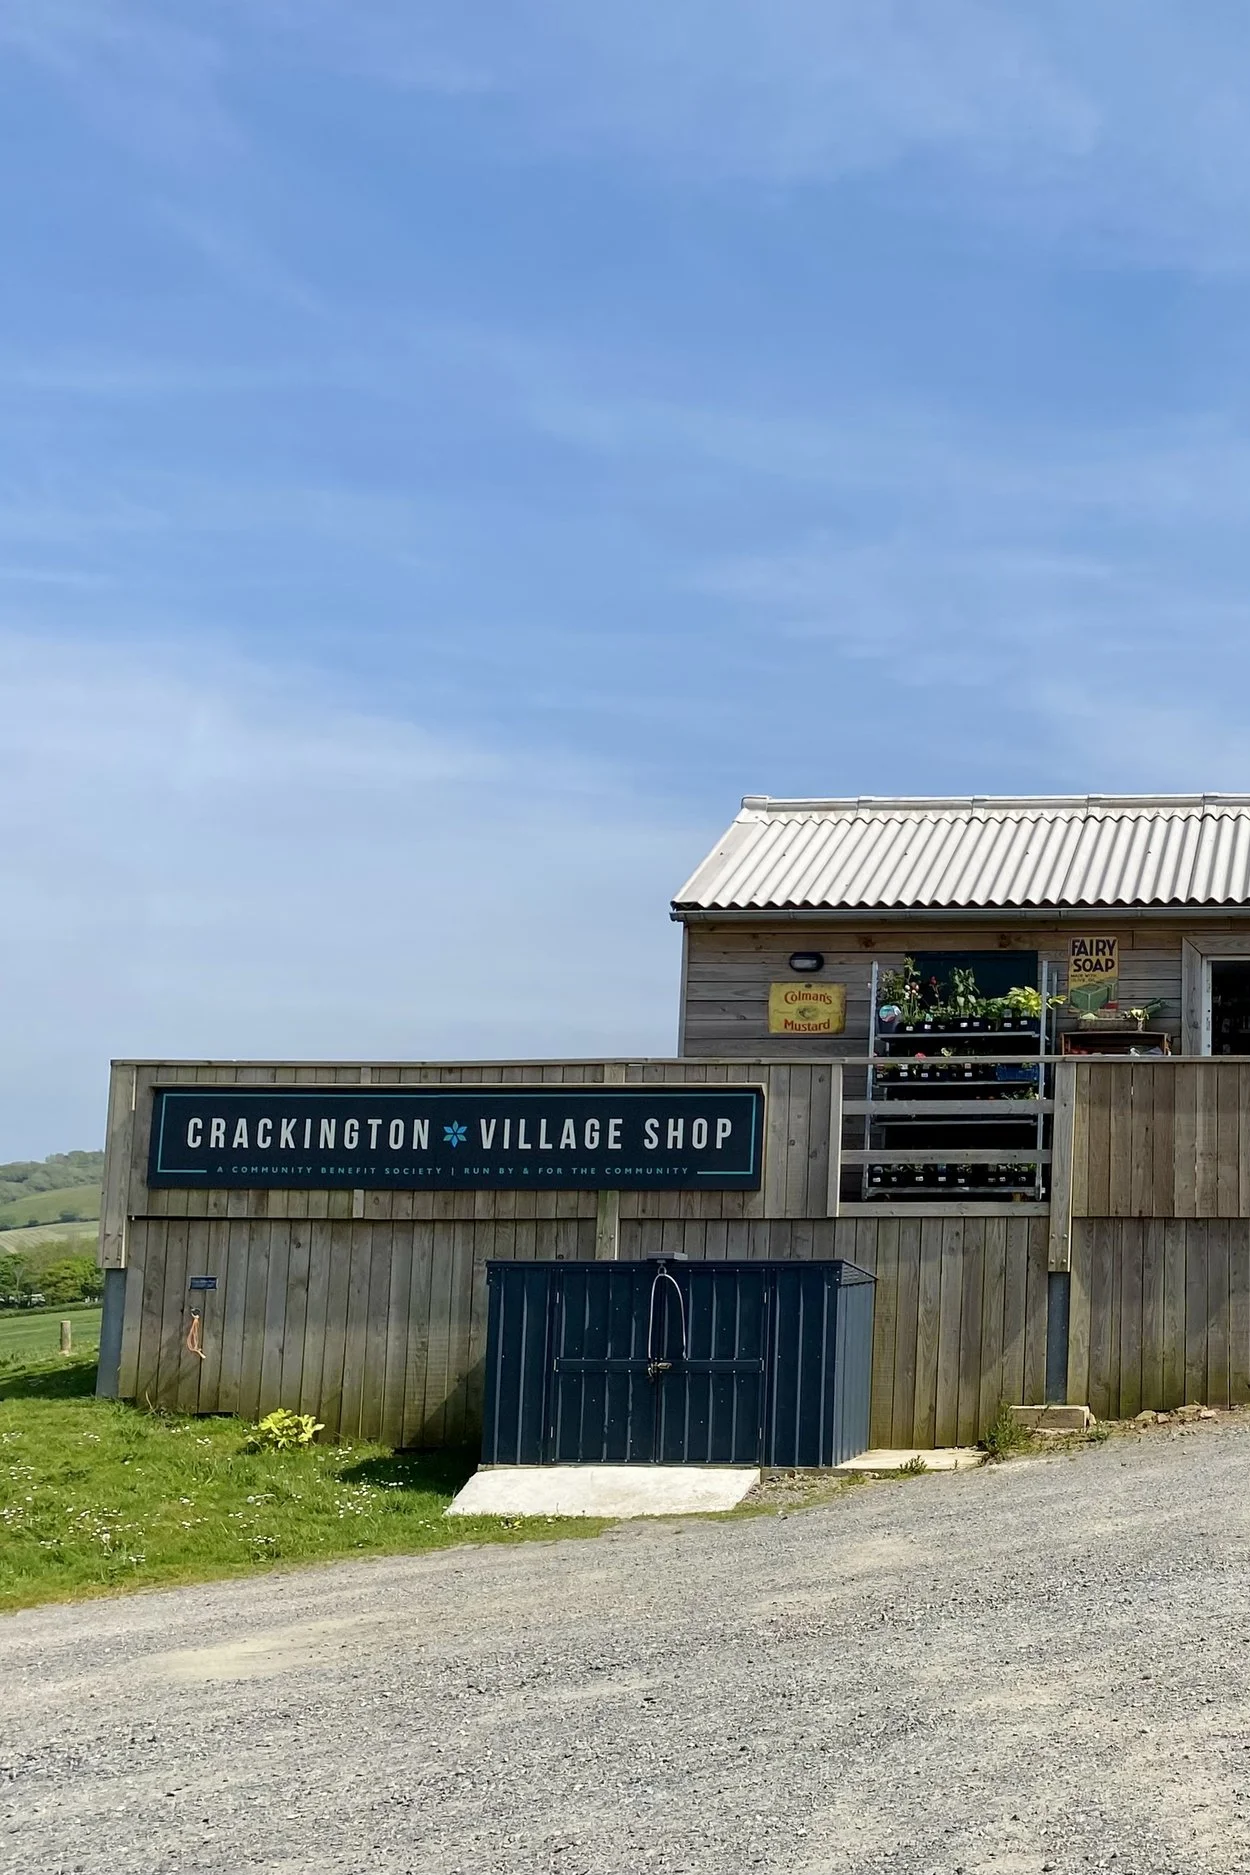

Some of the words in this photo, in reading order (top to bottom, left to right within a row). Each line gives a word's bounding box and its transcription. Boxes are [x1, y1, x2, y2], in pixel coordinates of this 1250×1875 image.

[1071, 938, 1117, 956] FAIRY
[1073, 958, 1115, 973] SOAP
[784, 990, 832, 1005] Colman's
[784, 1018, 830, 1032] Mustard
[186, 1117, 430, 1150] CRACKINGTON
[479, 1118, 624, 1150] VILLAGE
[643, 1118, 733, 1150] SHOP
[231, 1166, 313, 1174] COMMUNITY
[320, 1167, 376, 1175] BENEFIT
[384, 1167, 442, 1175] SOCIETY
[464, 1167, 490, 1175] RUN
[499, 1167, 514, 1175] BY
[522, 1167, 529, 1175] &
[538, 1167, 563, 1175] FOR
[571, 1167, 596, 1175] THE
[604, 1167, 689, 1175] COMMUNITY
